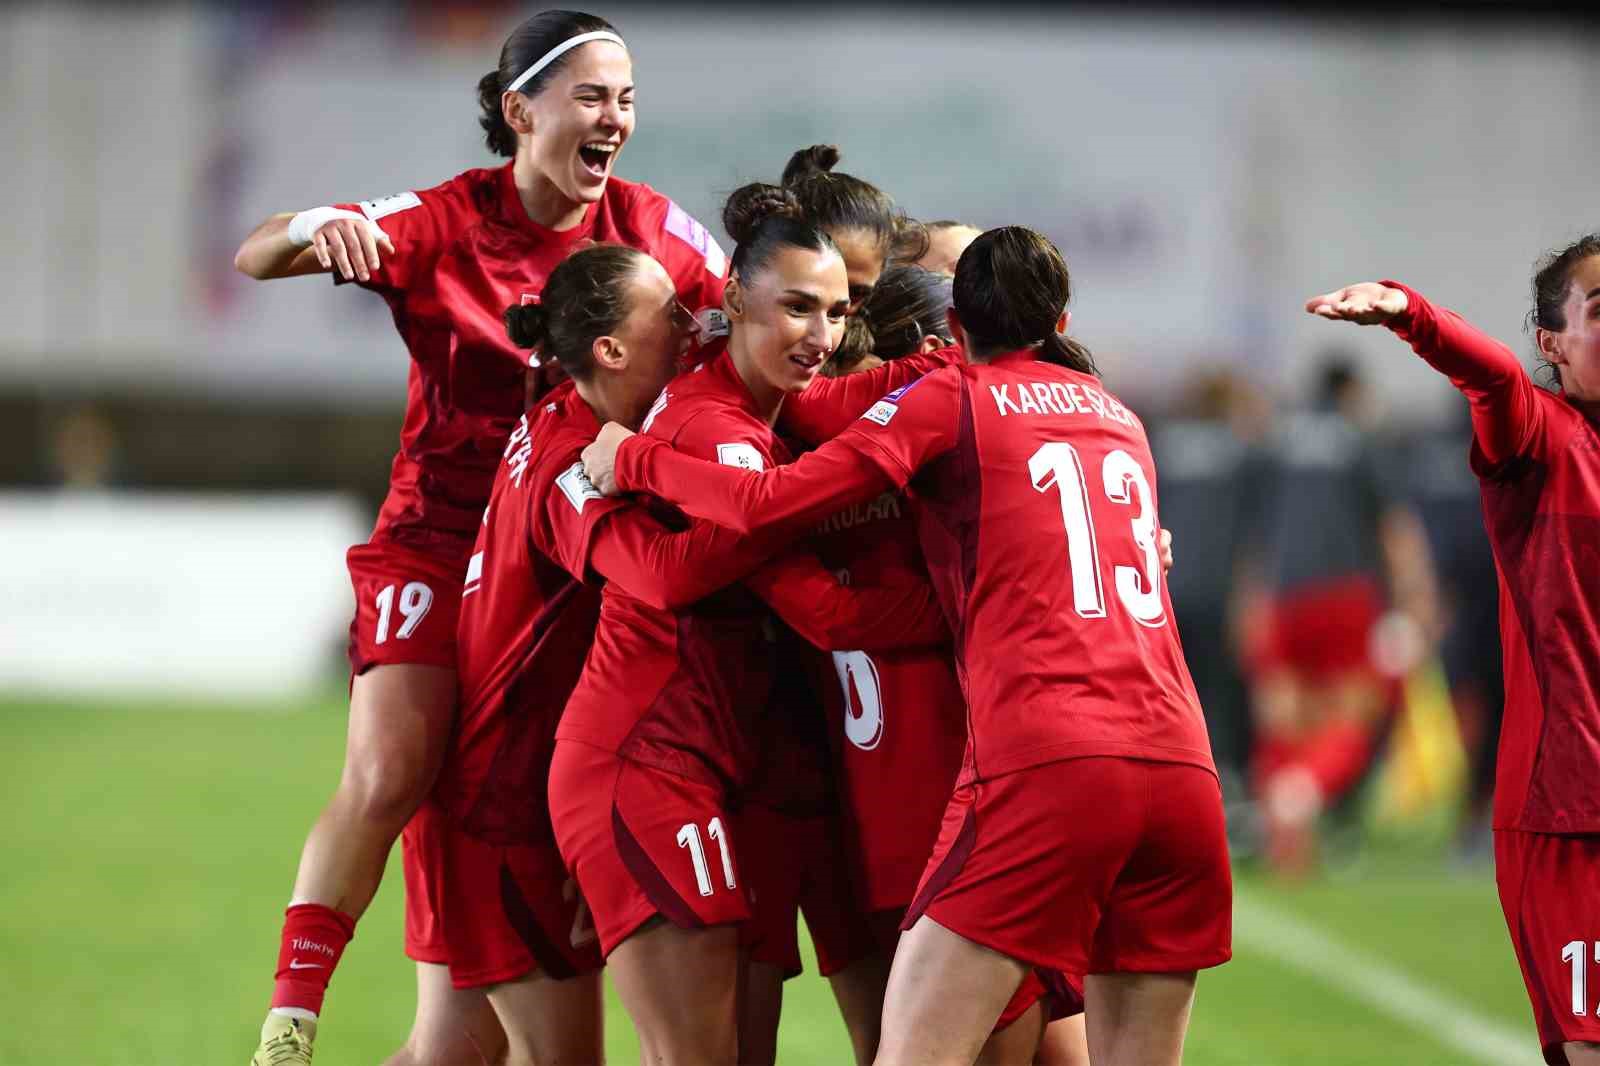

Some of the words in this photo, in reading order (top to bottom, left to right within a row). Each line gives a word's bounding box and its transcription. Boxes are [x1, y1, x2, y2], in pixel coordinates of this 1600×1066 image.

[1027, 441, 1168, 627] 13
[375, 581, 434, 645] 19
[676, 816, 737, 896] 11
